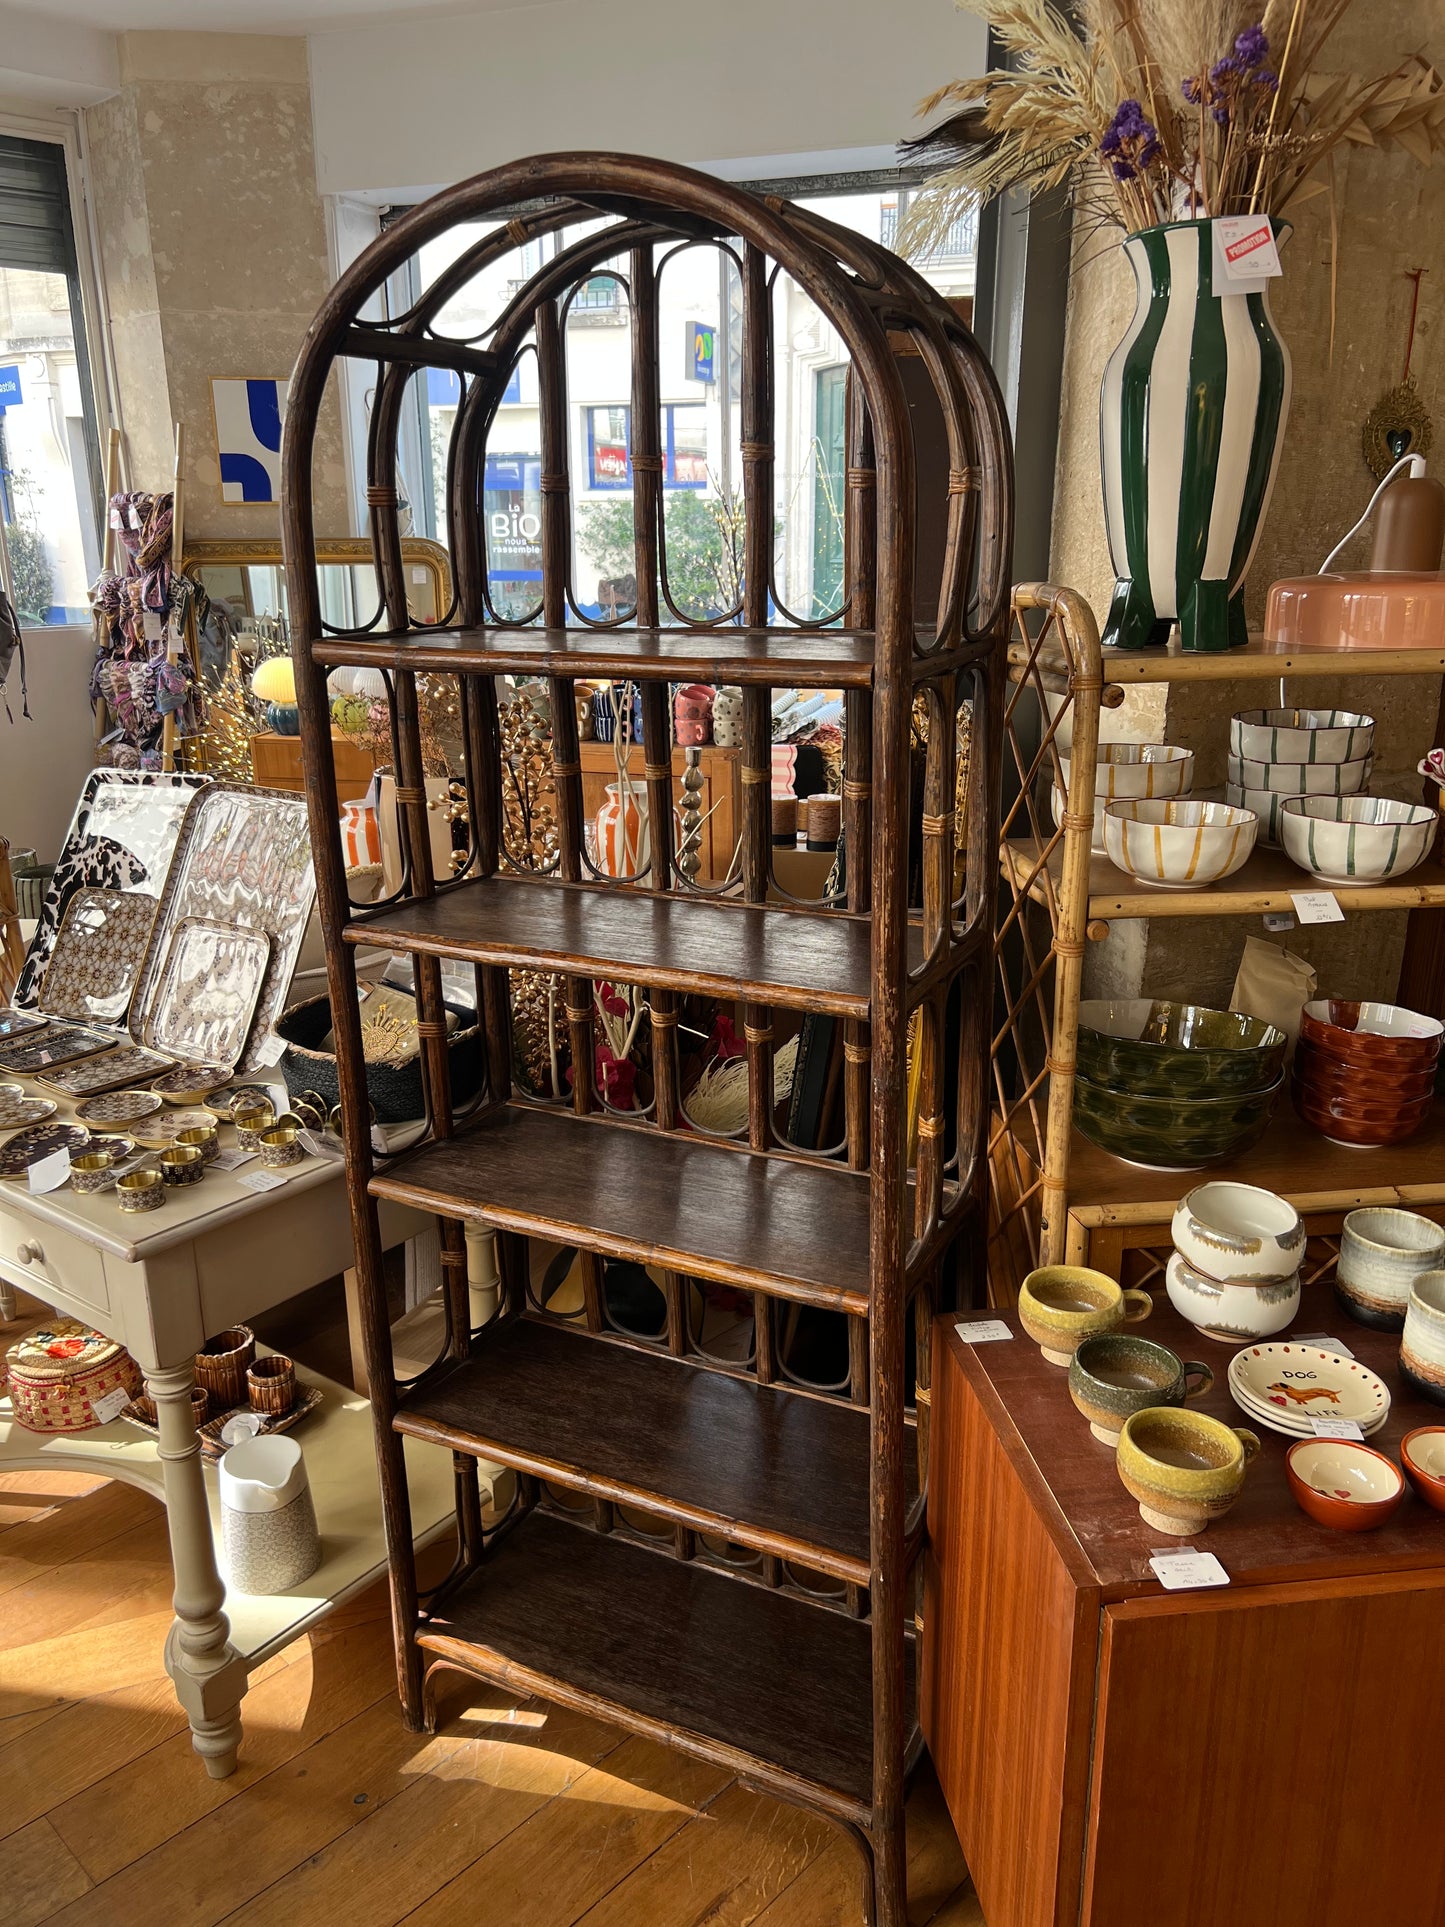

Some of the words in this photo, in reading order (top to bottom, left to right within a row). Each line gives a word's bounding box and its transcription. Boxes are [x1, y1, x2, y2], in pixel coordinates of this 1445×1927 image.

[508, 504, 520, 512] La
[492, 545, 540, 553] rassemble
[1282, 1370, 1317, 1379] DOG
[1304, 1409, 1344, 1417] LIFE
